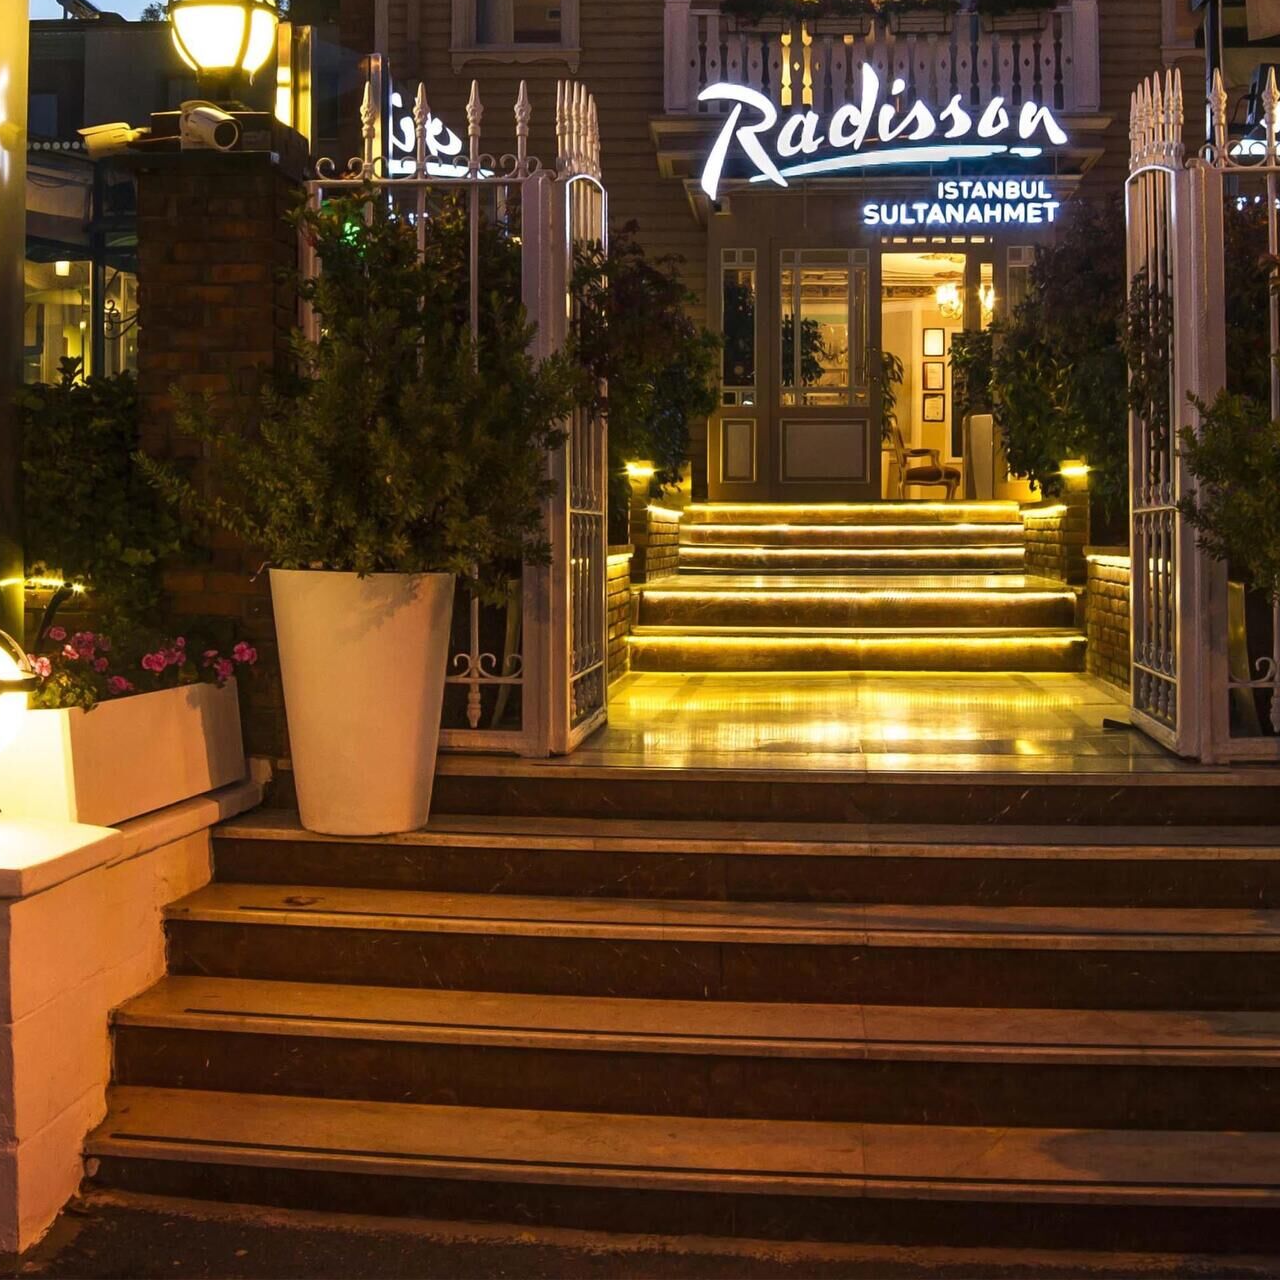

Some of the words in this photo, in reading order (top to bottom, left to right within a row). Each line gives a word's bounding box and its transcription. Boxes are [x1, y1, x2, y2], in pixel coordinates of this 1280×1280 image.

[697, 62, 1068, 201] Radisson
[937, 180, 1053, 200] ISTANBUL
[862, 201, 1060, 226] SULTANAHMET
